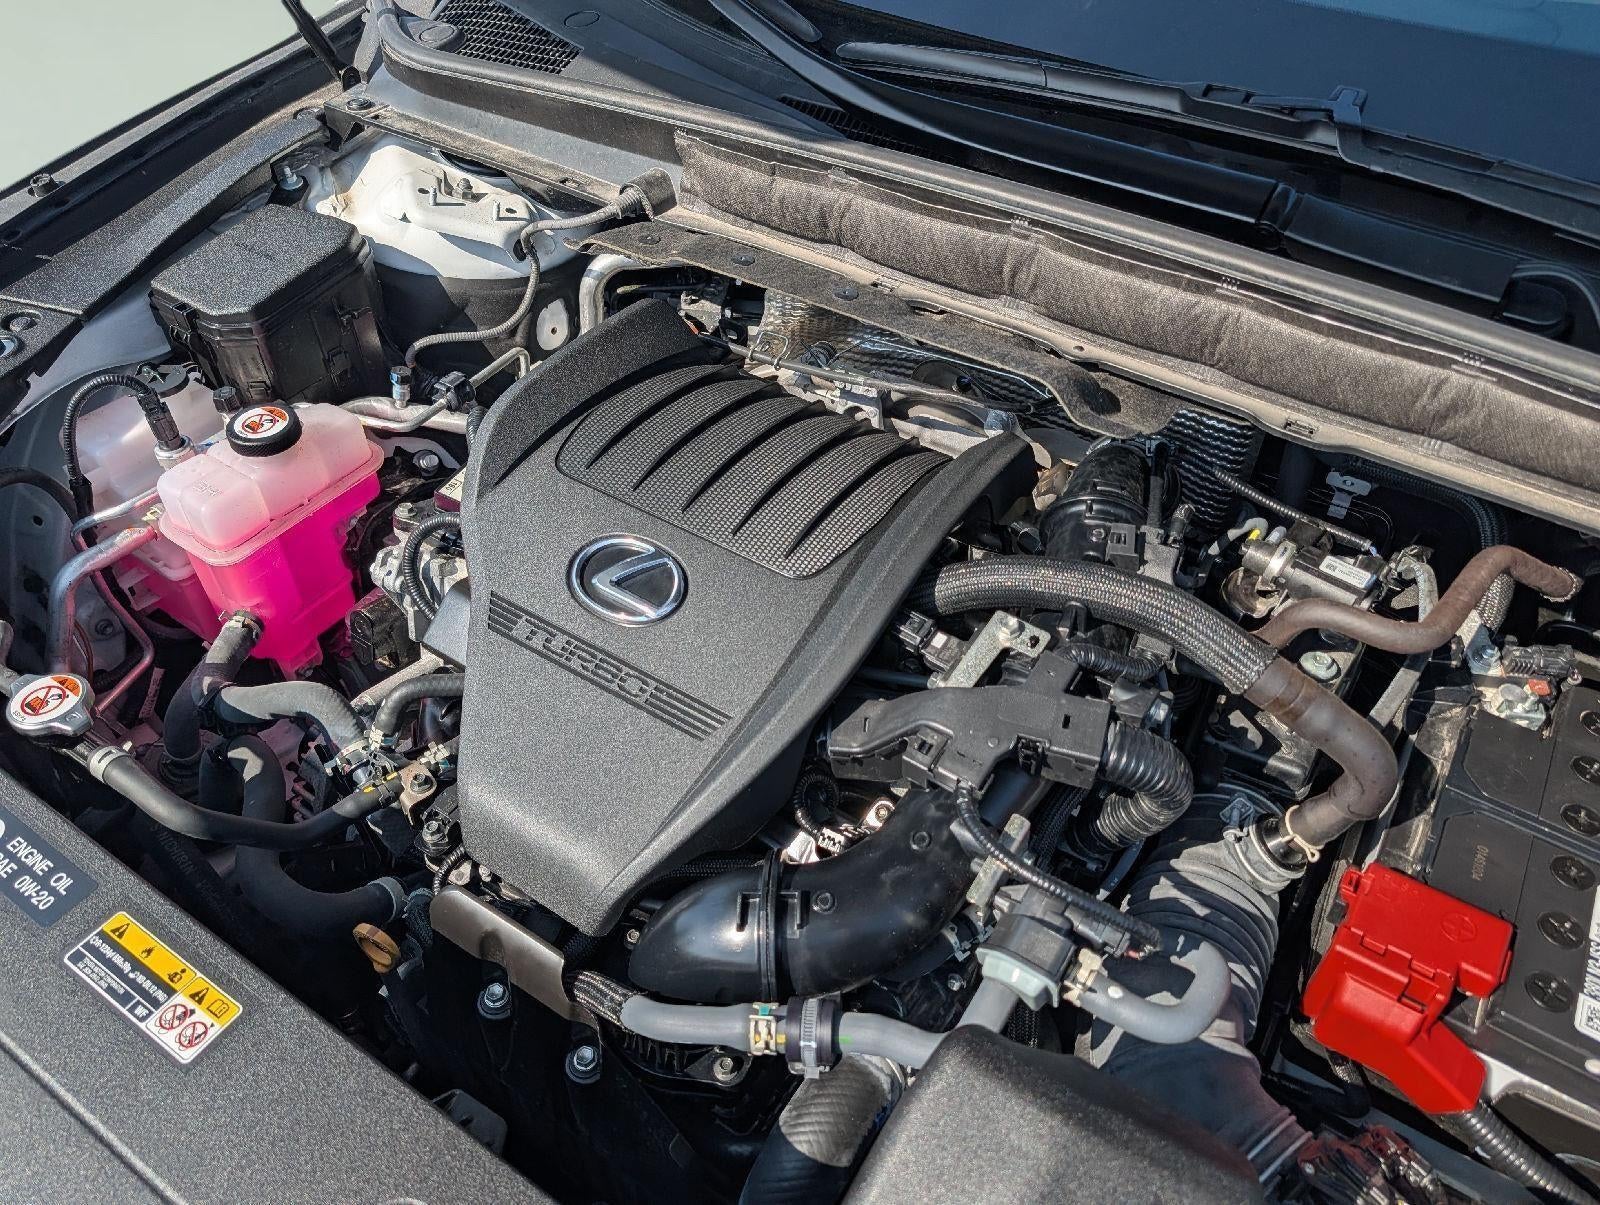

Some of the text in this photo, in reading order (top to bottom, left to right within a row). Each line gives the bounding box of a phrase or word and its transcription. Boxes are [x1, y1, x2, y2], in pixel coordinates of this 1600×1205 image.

[511, 616, 656, 702] TURBO
[7, 836, 75, 895] ENGINE OIL
[14, 874, 55, 910] 0W-20
